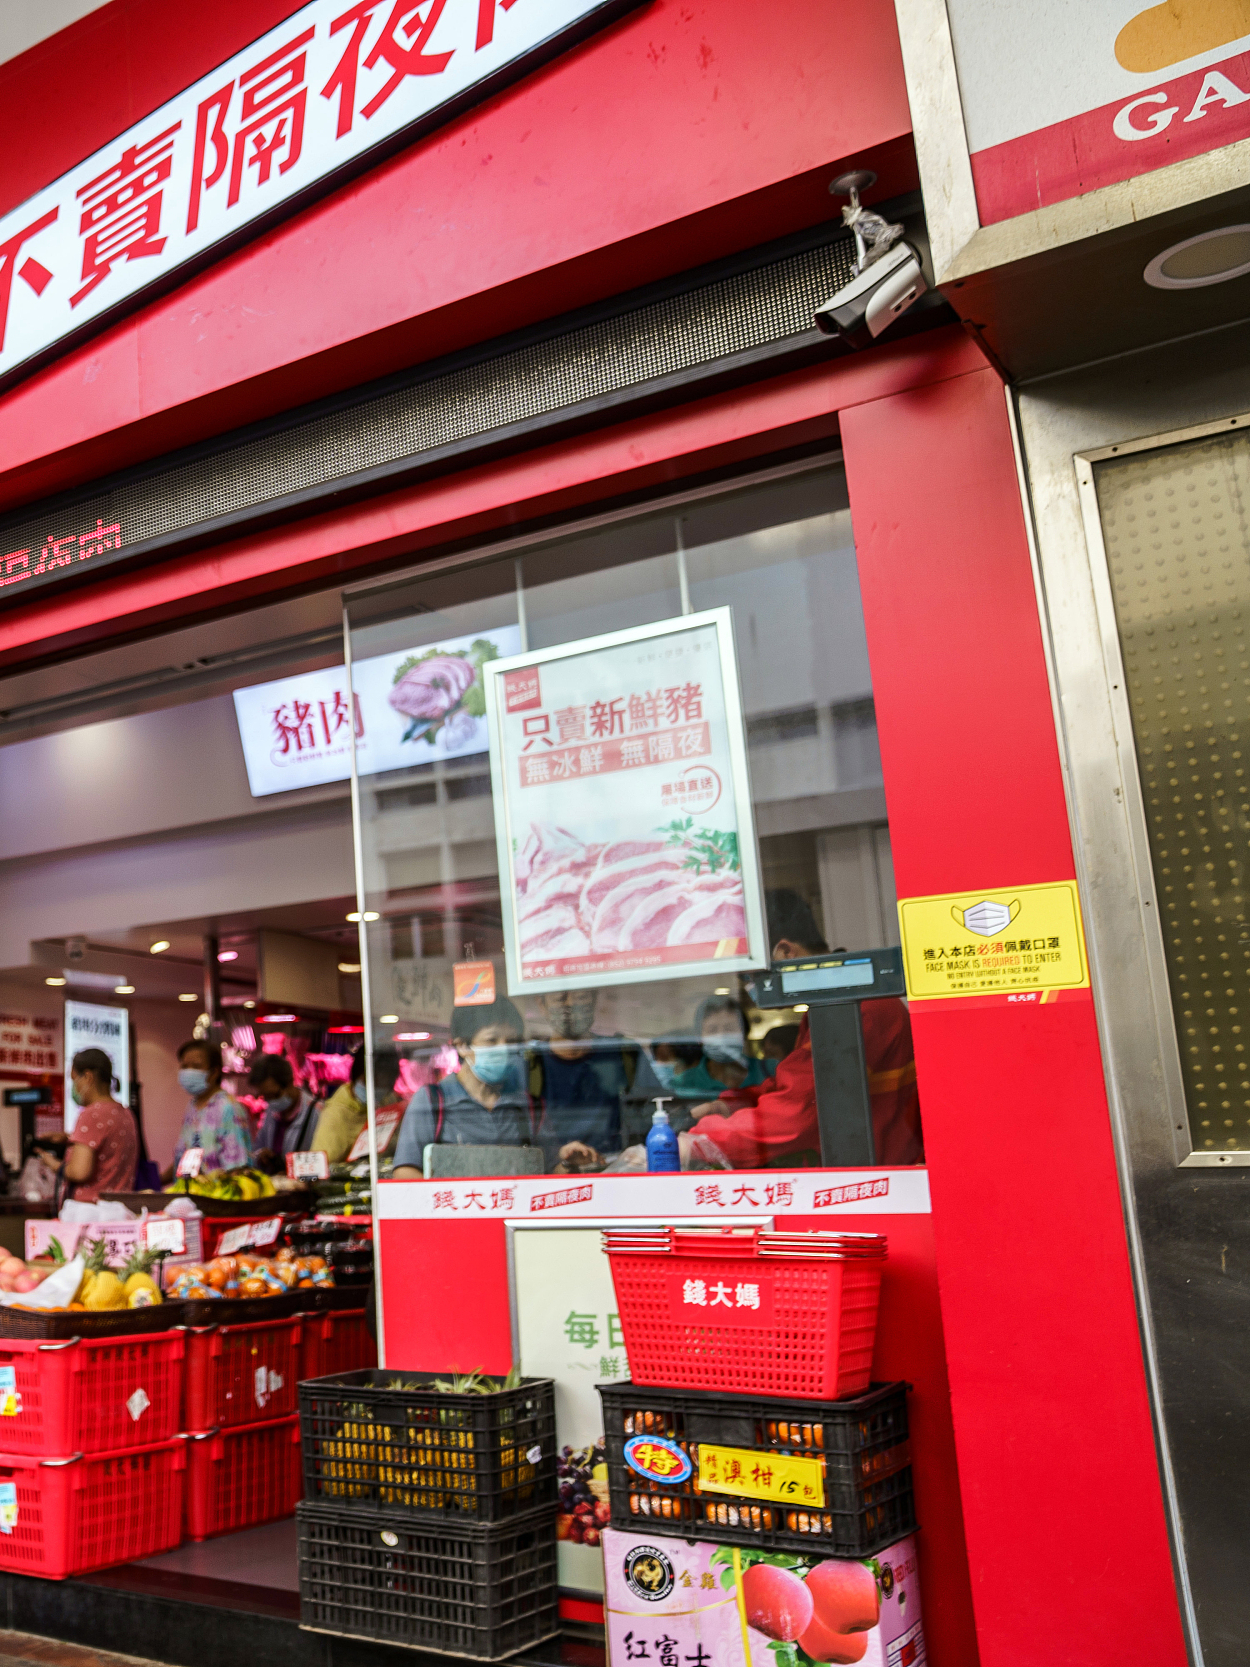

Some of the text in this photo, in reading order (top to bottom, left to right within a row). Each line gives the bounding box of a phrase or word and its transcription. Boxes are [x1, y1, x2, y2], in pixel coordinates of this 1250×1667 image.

[270, 691, 365, 754] 豬肉
[521, 681, 704, 752] 只賣新鮮豬
[524, 729, 705, 784] 無冰鮮 無隔夜
[923, 937, 1060, 960] 進入本店必須佩戴口罩
[926, 953, 1061, 973] FACE MASK IS REQUIRED TO ENTER
[432, 1185, 592, 1211] 錢大媽 不賣隔夜肉
[693, 1180, 888, 1208] 錢大媽 不賣隔夜肉
[682, 1278, 761, 1310] 錢大媽
[634, 1443, 681, 1476] 特
[779, 1481, 801, 1494] 15
